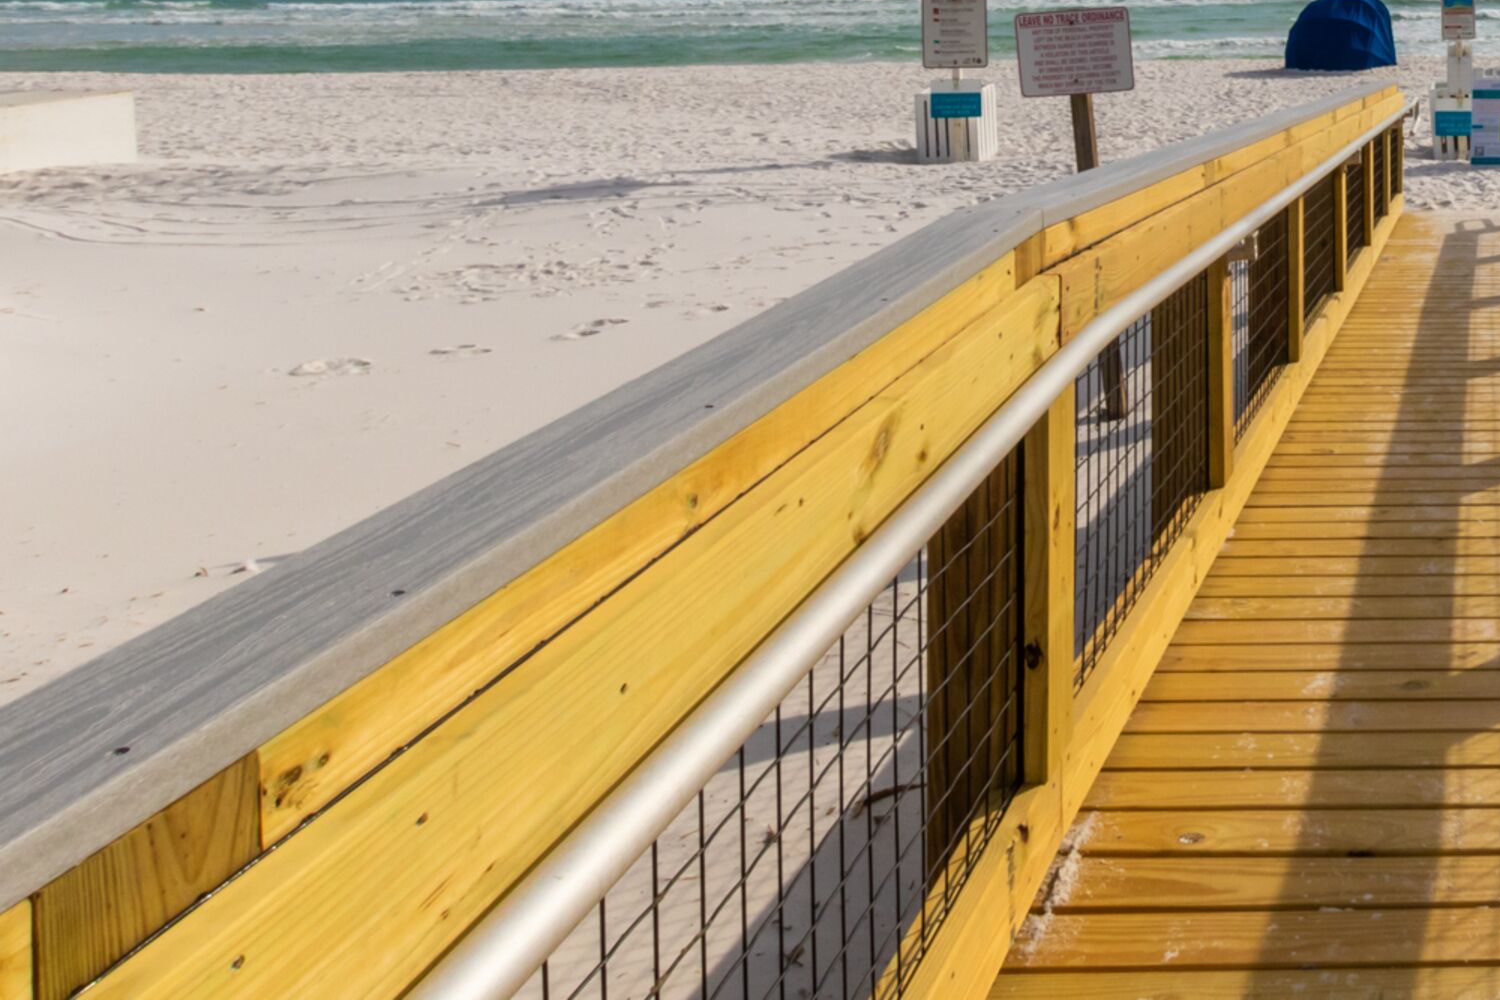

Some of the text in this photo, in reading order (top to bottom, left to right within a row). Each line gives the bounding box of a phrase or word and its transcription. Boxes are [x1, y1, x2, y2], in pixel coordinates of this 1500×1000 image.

[1019, 10, 1124, 26] LEAVE NO TRACE ORDINANCE
